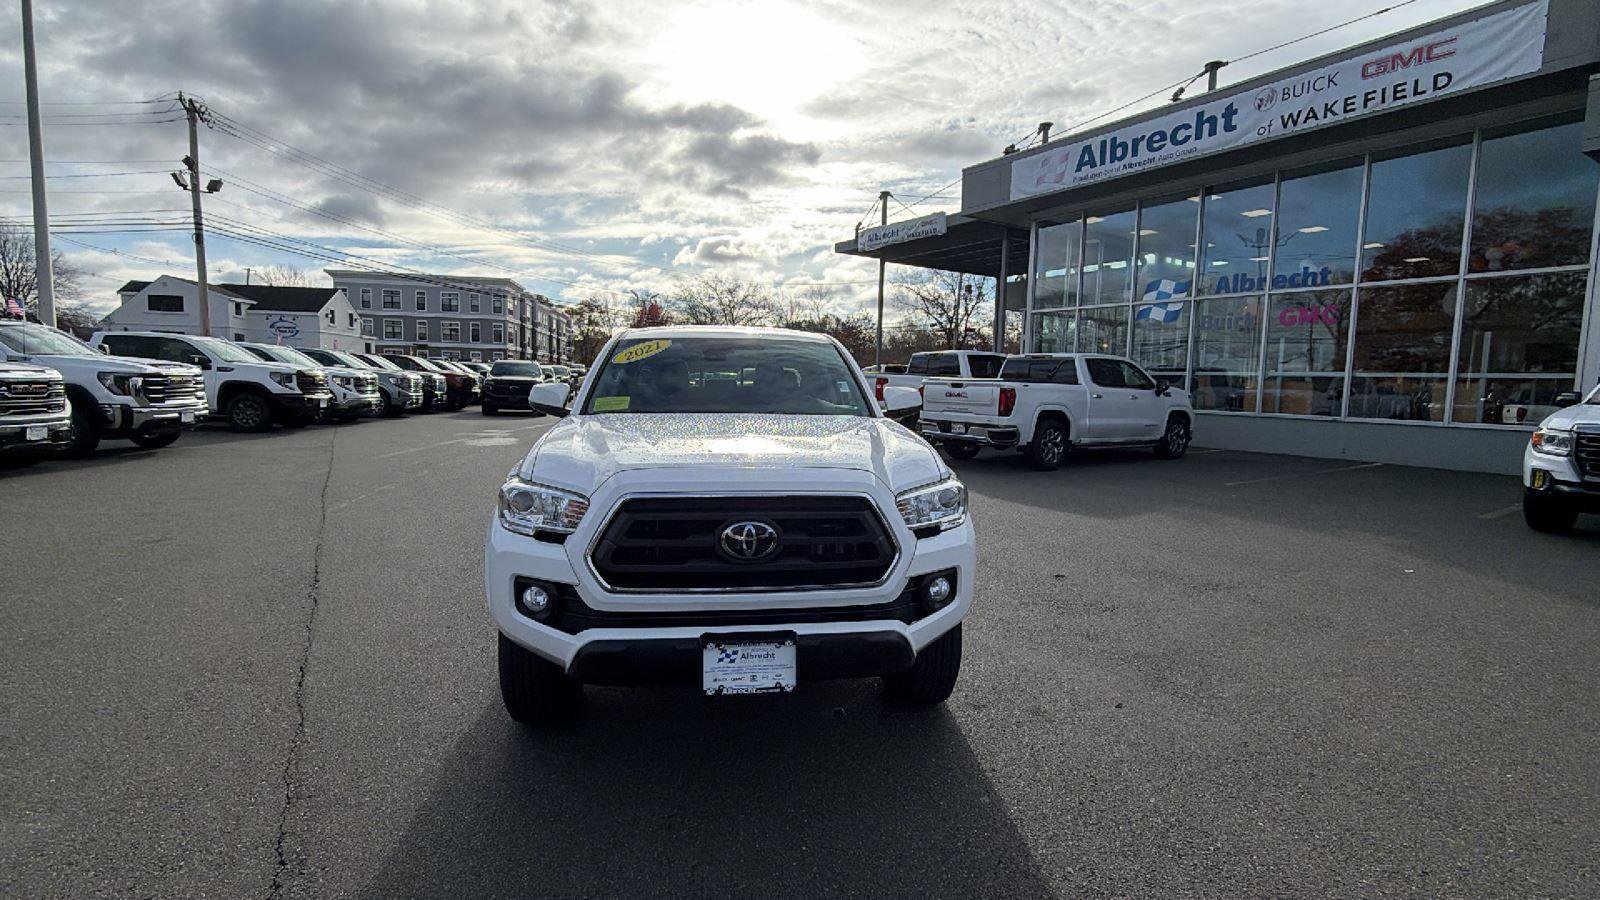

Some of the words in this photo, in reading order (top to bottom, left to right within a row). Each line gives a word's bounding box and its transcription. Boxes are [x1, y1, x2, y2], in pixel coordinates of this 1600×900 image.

[1281, 71, 1340, 102] BUICK
[1361, 36, 1460, 80] GMC
[1257, 119, 1274, 136] of
[1280, 71, 1453, 129] WAKEFIELD
[1075, 102, 1239, 173] Albrecht
[1122, 156, 1156, 171] Albrecht
[1215, 266, 1331, 294] Albrecht
[1279, 303, 1340, 327] GMC
[625, 341, 660, 360] 2021
[740, 651, 775, 660] Albrecht
